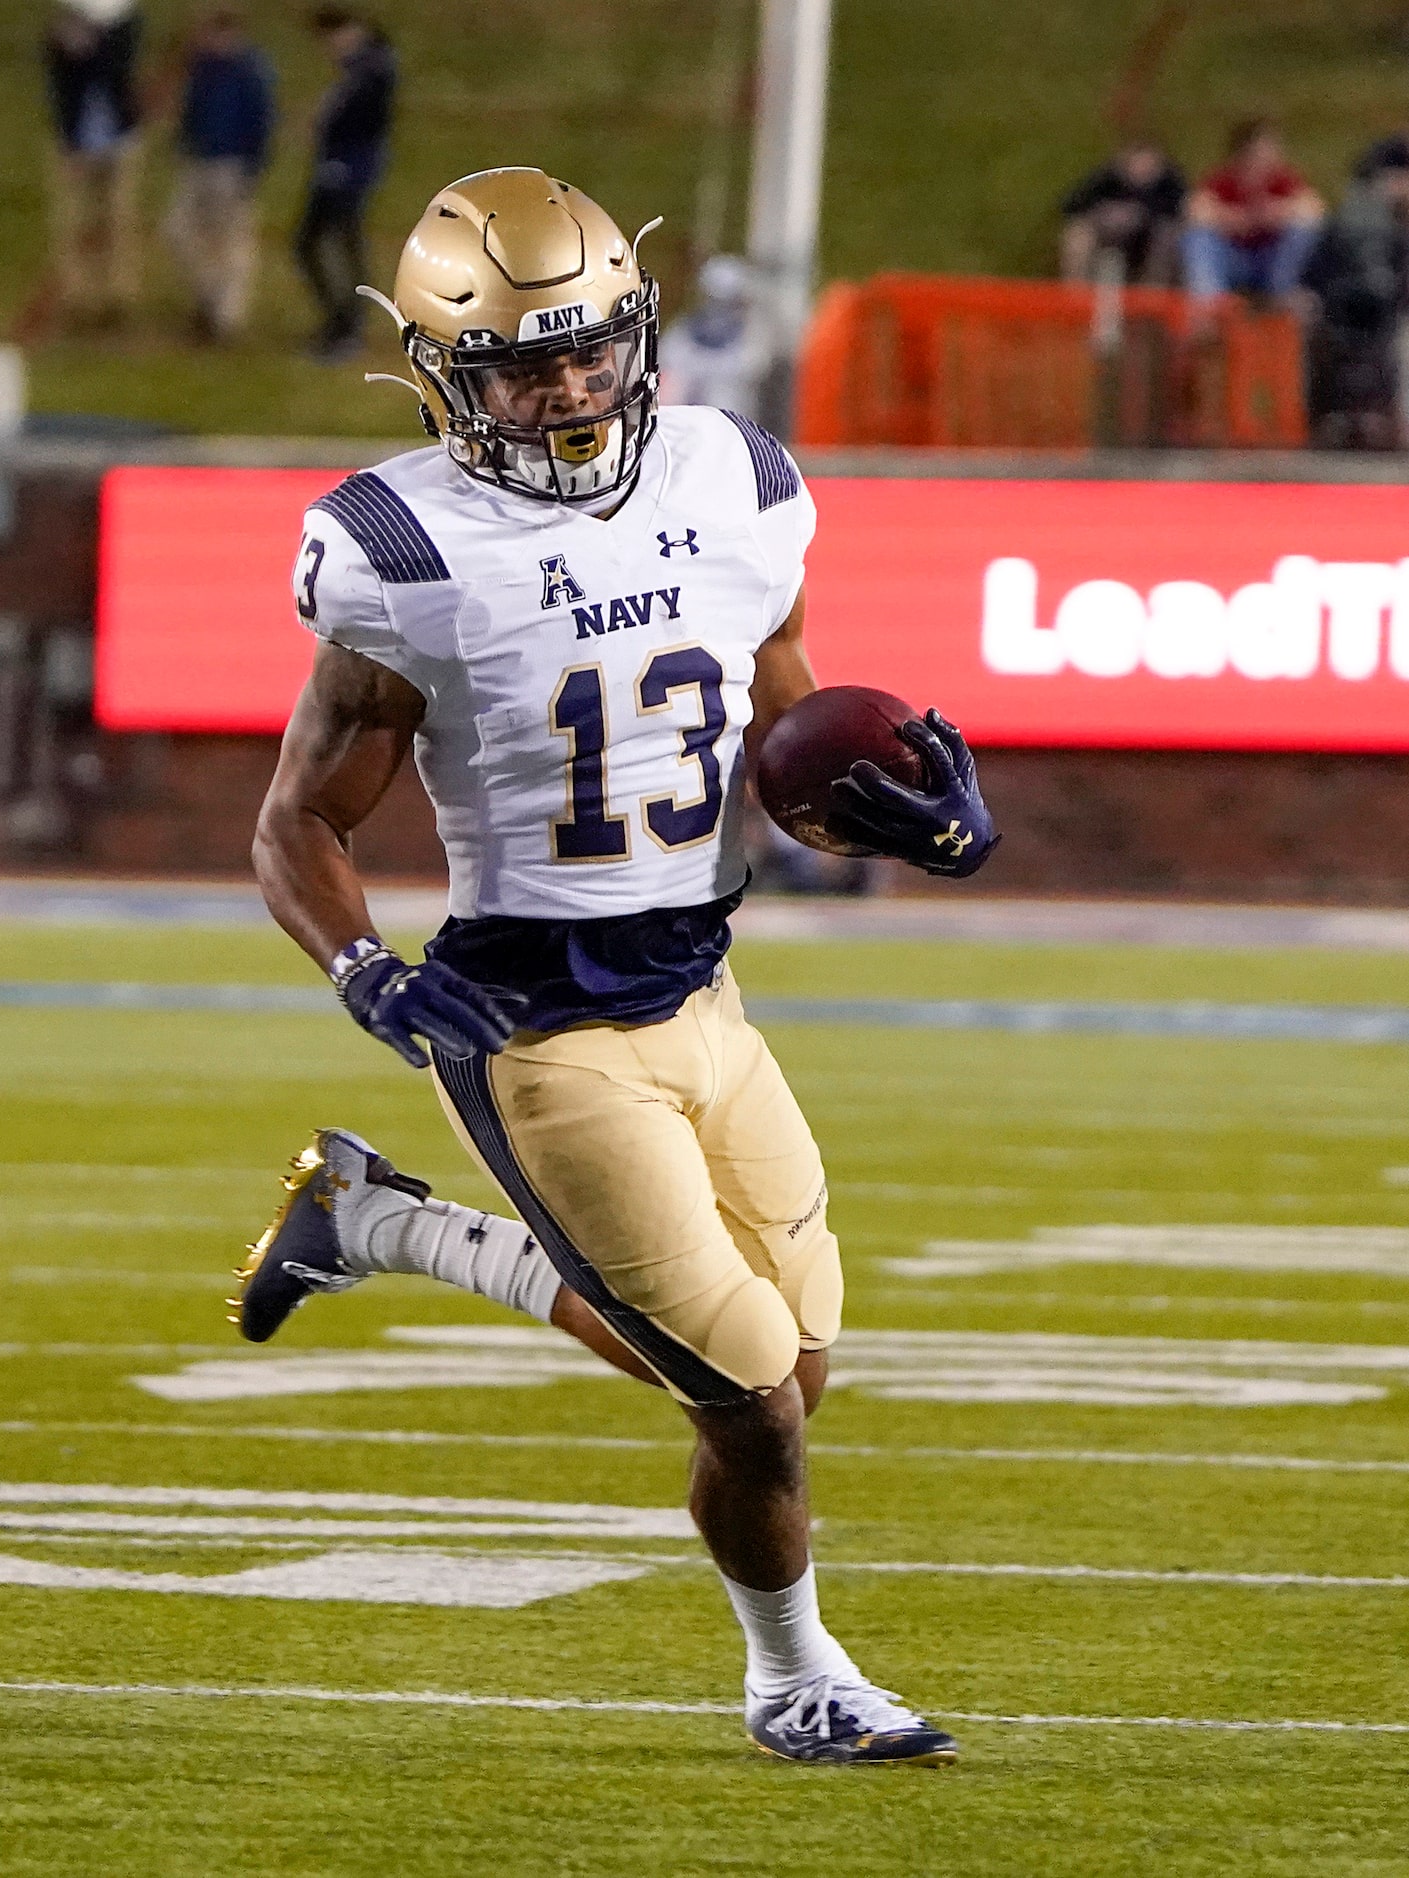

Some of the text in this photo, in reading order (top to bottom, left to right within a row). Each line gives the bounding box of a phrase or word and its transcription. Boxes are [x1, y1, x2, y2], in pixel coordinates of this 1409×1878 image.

[536, 305, 585, 334] NAVY
[539, 553, 586, 610] A
[571, 586, 681, 640] NAVY
[548, 638, 730, 867] 13
